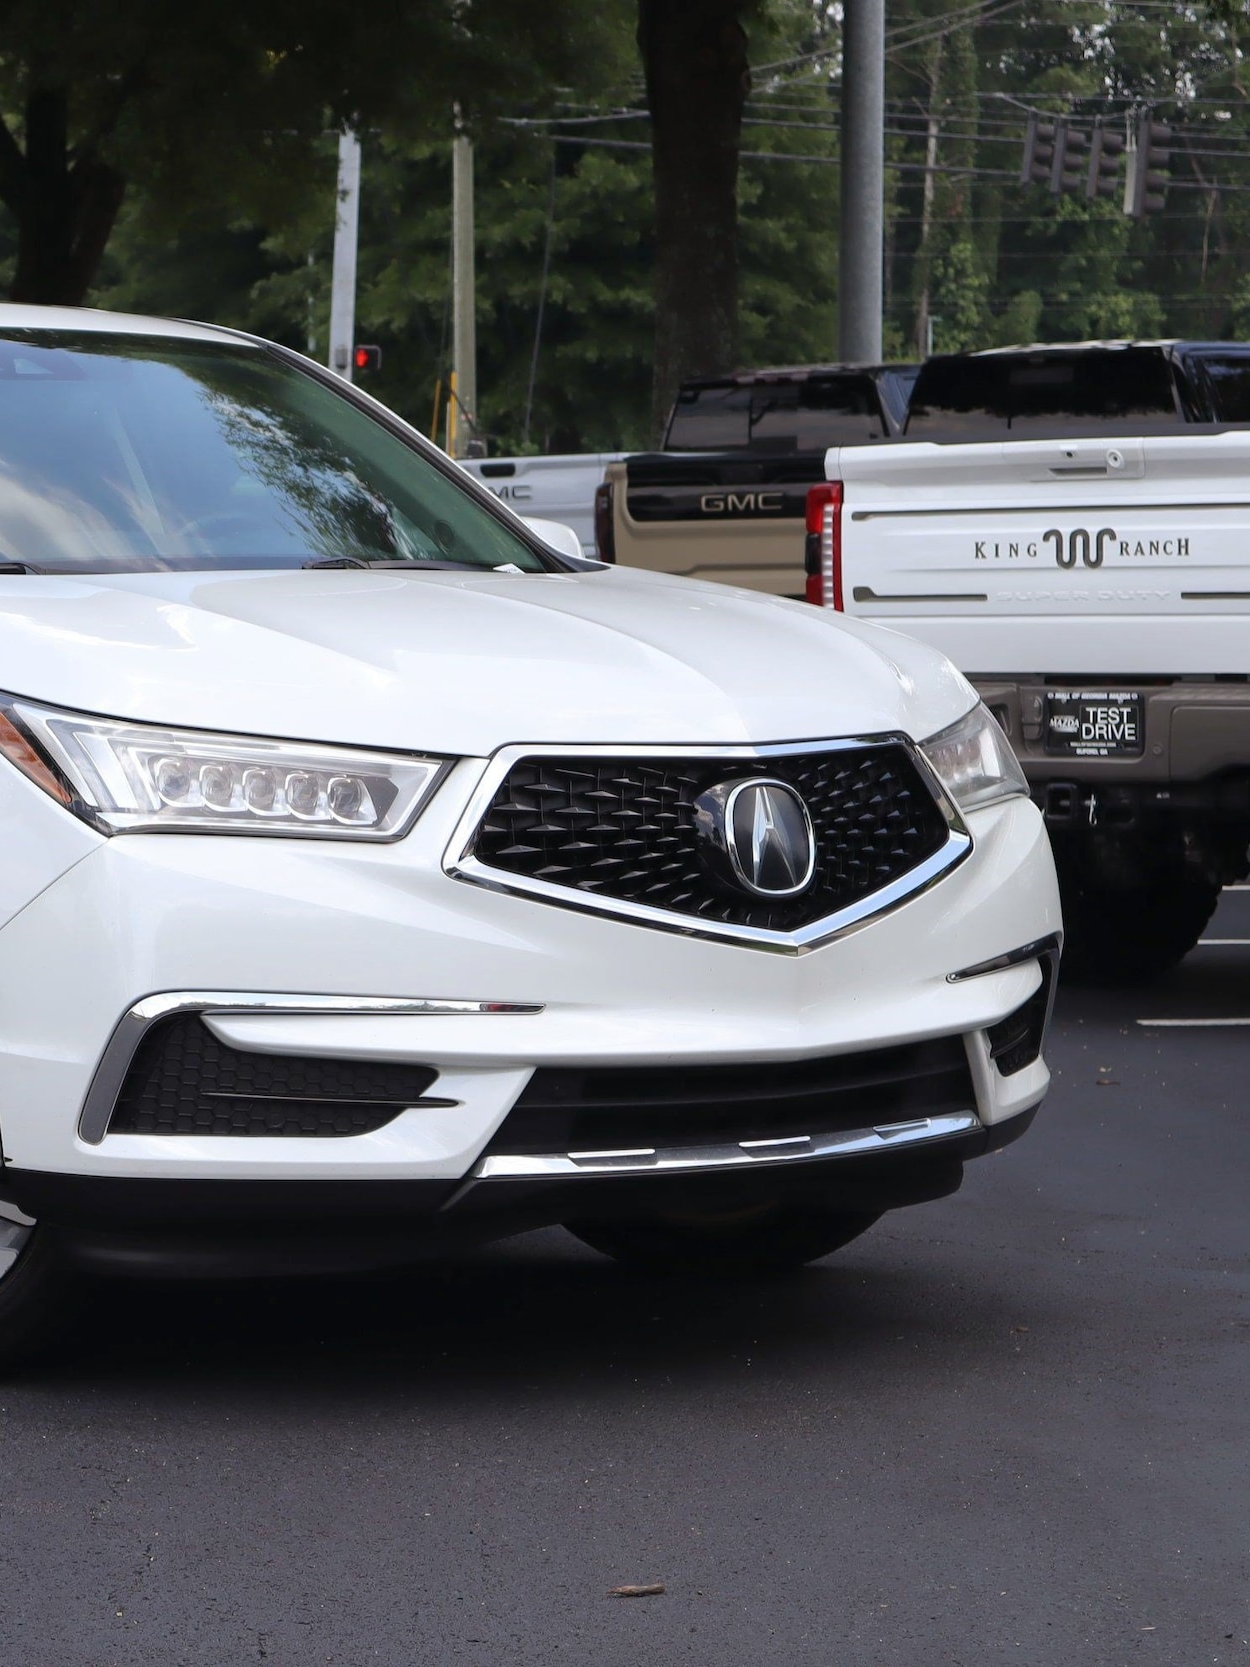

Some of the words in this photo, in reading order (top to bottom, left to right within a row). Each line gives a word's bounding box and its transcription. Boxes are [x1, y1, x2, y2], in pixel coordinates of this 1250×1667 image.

[487, 486, 532, 499] MC
[701, 492, 783, 512] GMC
[975, 541, 1038, 559] KING
[1119, 538, 1190, 556] RANCH
[1049, 718, 1080, 729] MAZDA
[1086, 707, 1131, 724] TEST
[1082, 723, 1136, 740] DRIVE
